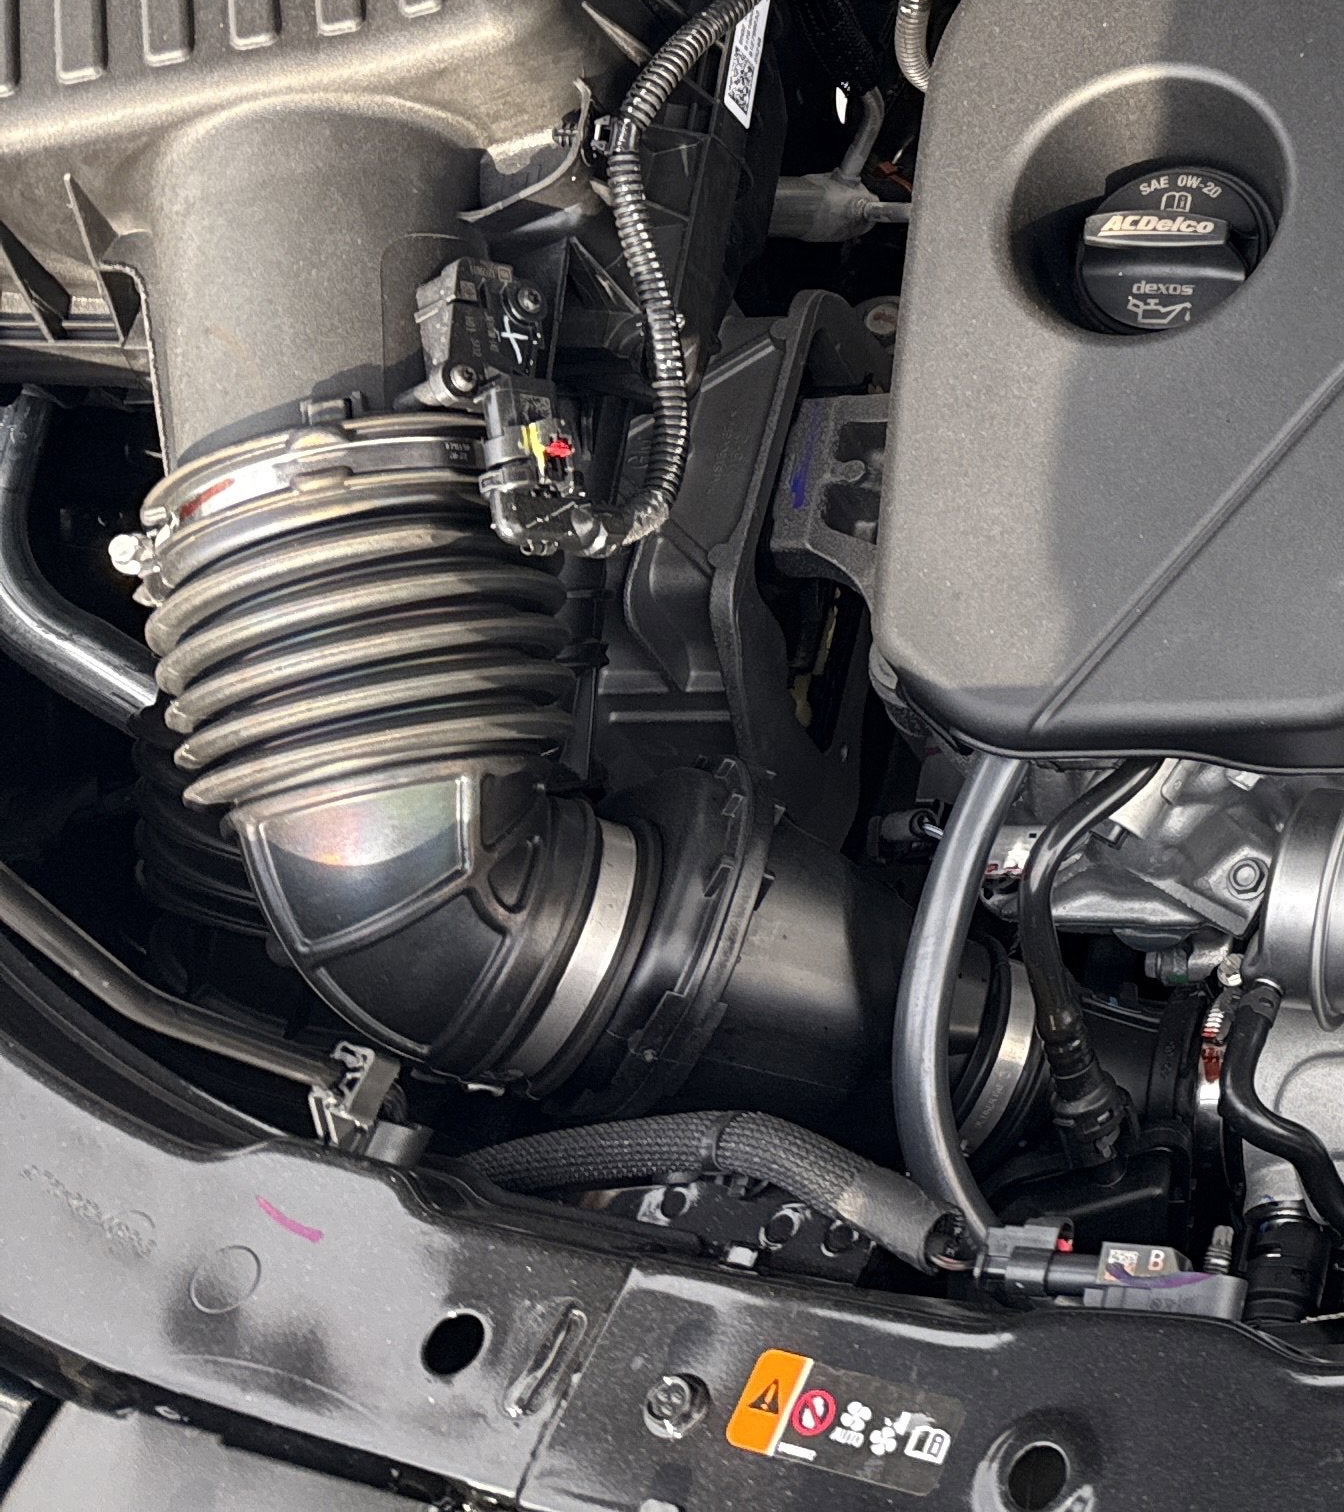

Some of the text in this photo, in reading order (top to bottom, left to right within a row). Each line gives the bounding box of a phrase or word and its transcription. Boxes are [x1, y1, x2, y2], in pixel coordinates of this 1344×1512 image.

[1138, 174, 1223, 199] SAE 0W-20
[1100, 214, 1216, 234] ACDelco
[1131, 280, 1194, 296] dexos
[1147, 1249, 1165, 1271] B
